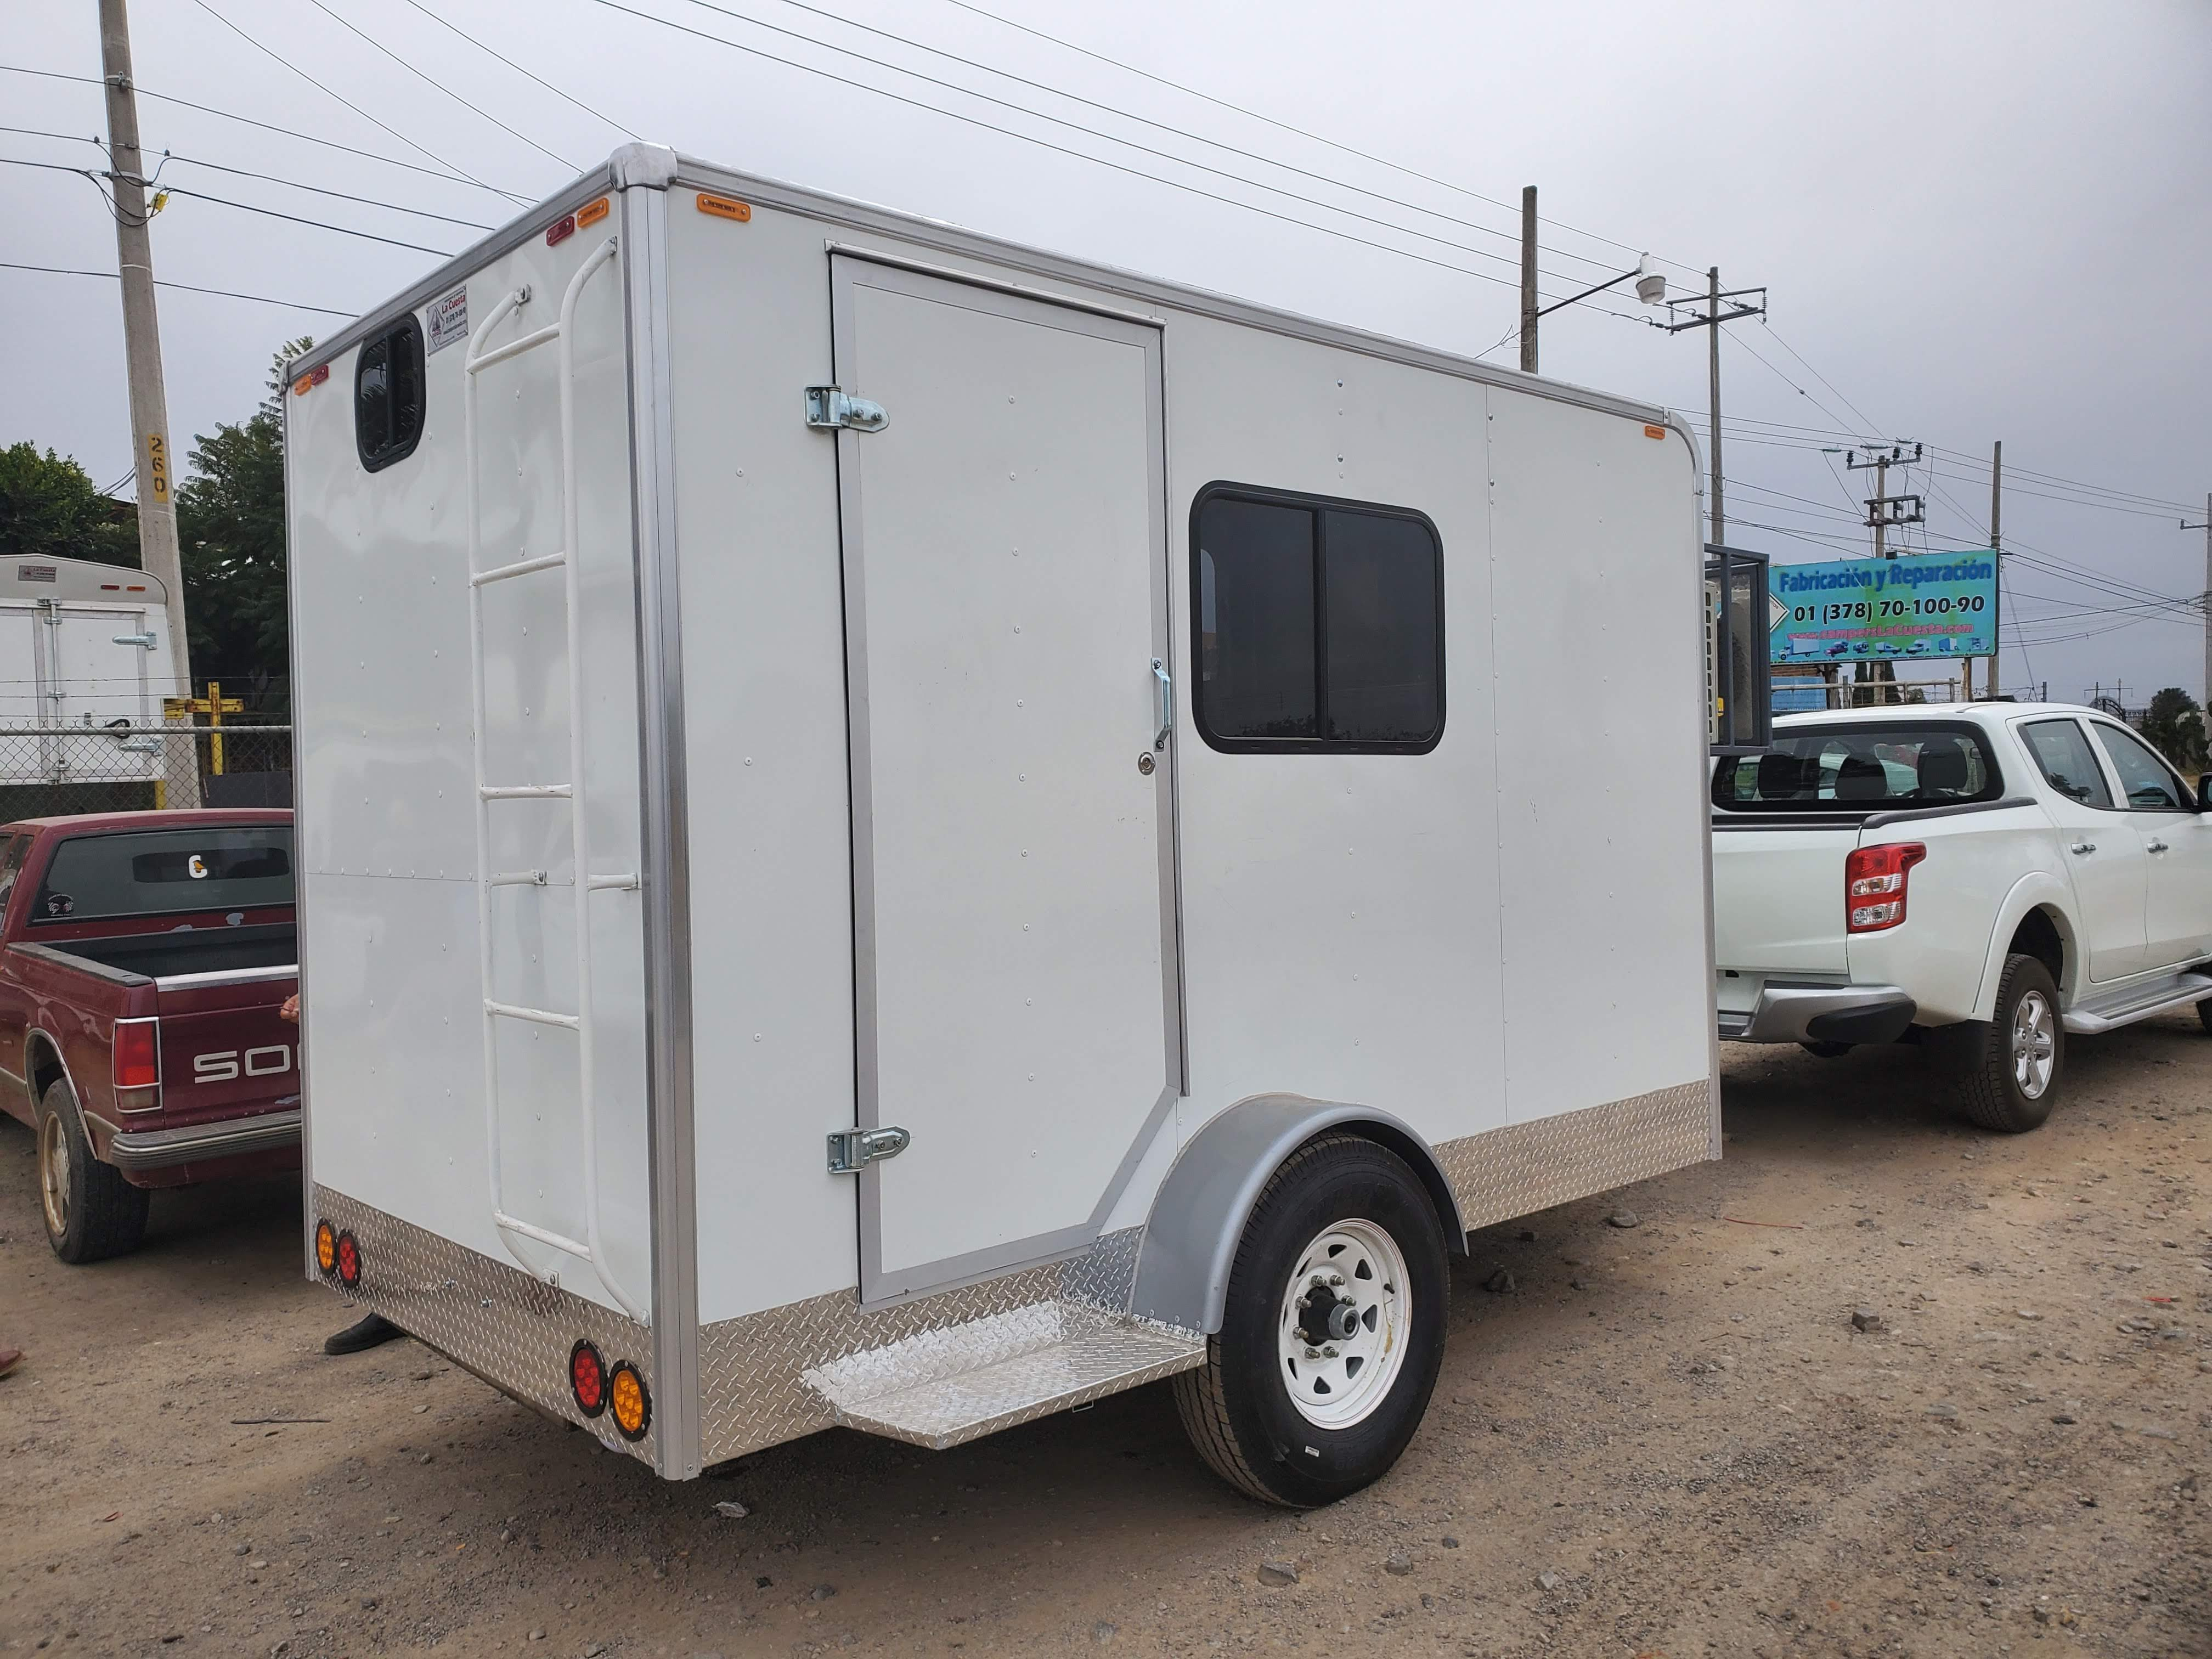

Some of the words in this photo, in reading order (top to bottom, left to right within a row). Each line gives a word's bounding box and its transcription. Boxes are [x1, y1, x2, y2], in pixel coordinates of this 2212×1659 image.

[442, 304, 448, 314] La
[448, 294, 465, 310] Cuesta
[151, 437, 166, 493] 260
[1779, 568, 1872, 592] Fabricación
[1875, 569, 1886, 591] y
[1889, 559, 1993, 590] Reparación
[1794, 605, 1815, 622] 01
[1822, 602, 1872, 625] (378)
[1879, 595, 1985, 617] 70-100-90
[194, 1044, 300, 1084] SO
